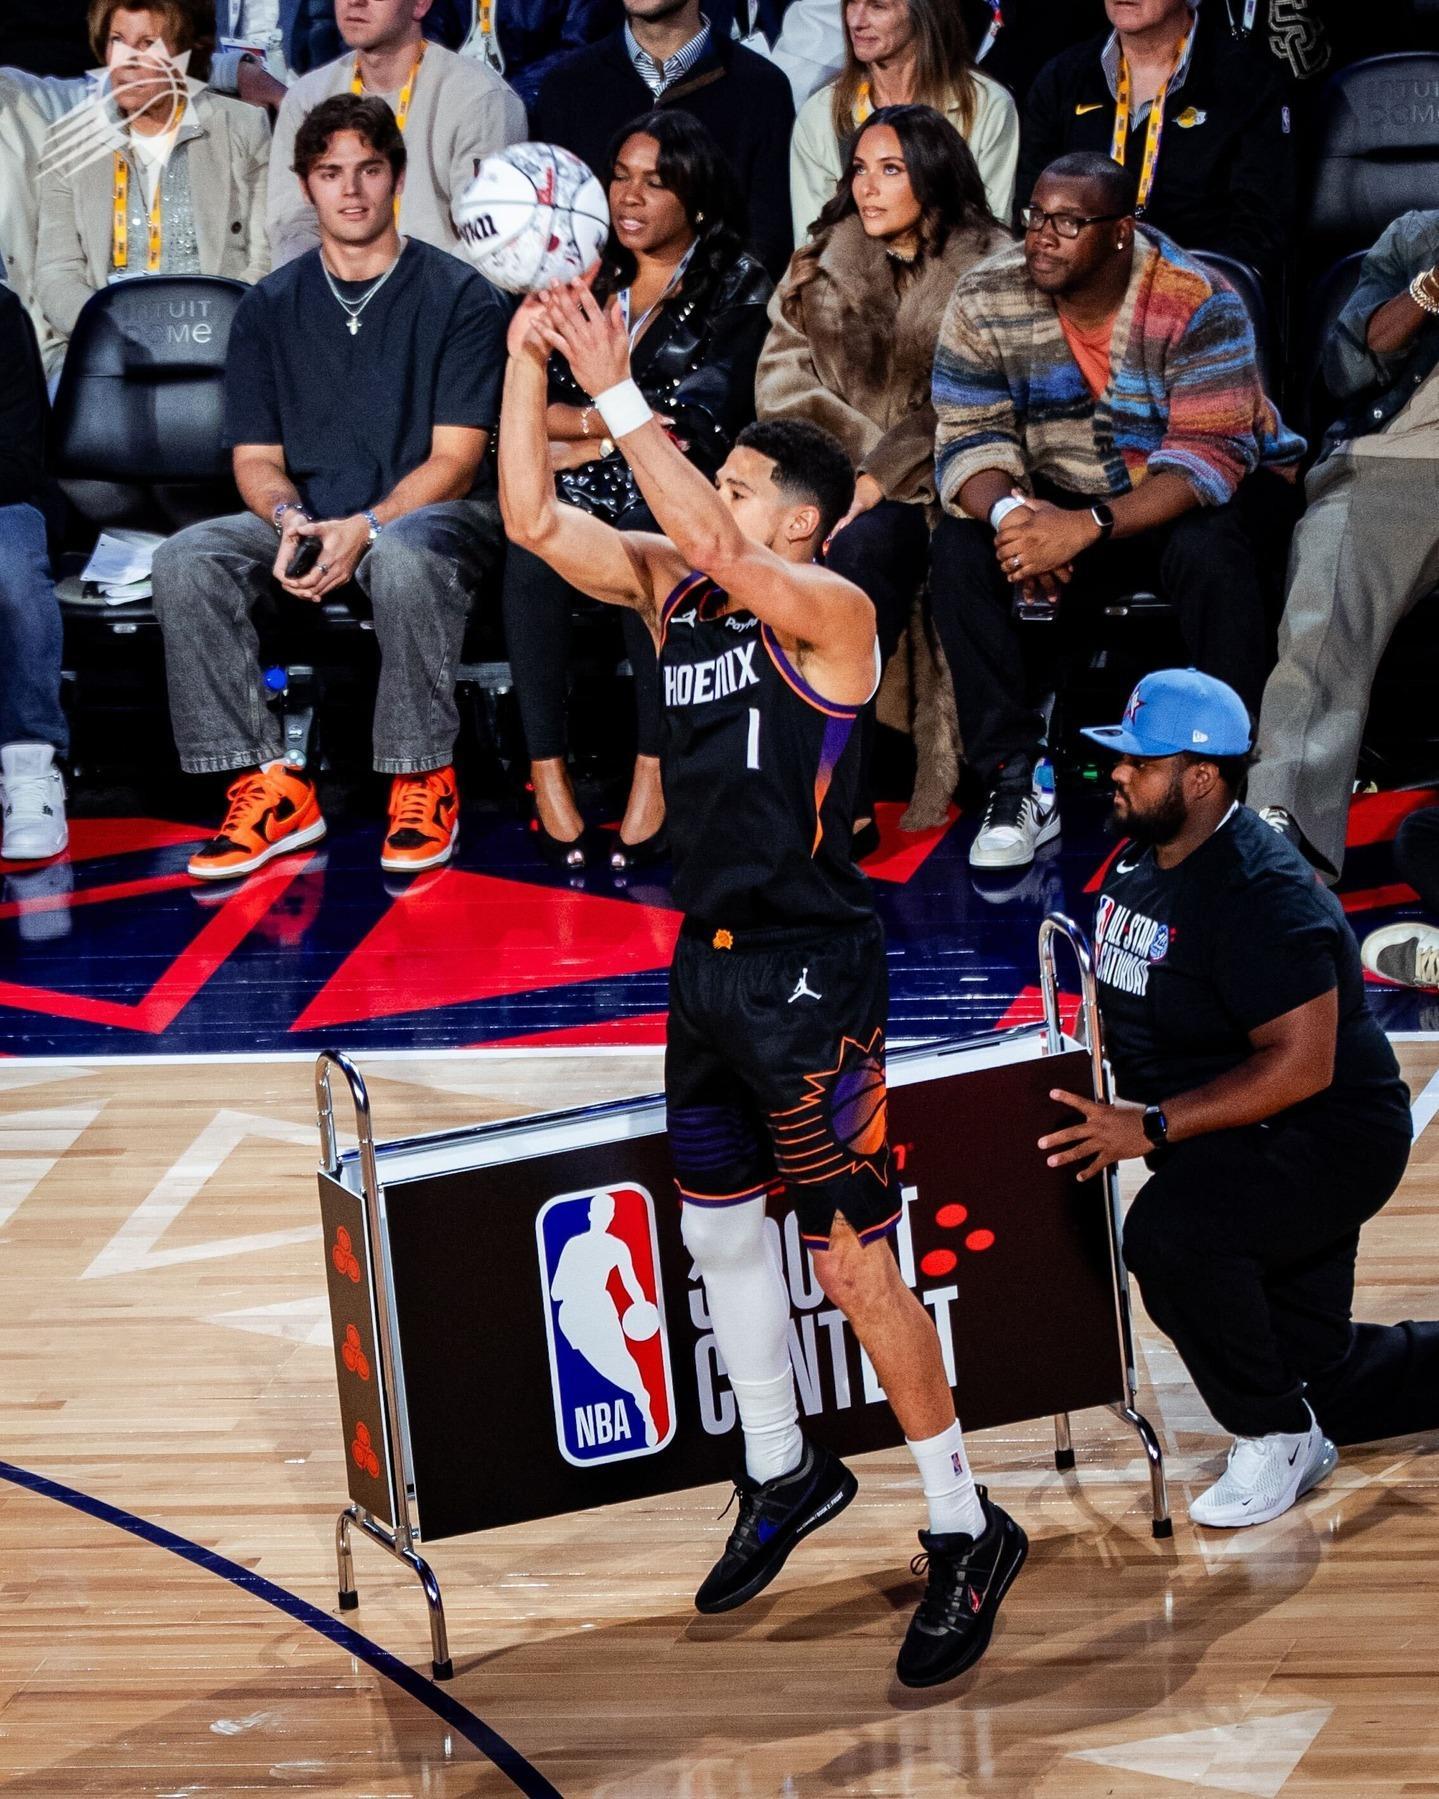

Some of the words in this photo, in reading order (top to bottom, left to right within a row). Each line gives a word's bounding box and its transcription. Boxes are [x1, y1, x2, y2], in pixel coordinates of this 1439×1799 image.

[123, 300, 212, 319] TUIT
[746, 707, 761, 771] 1
[694, 1285, 959, 1435] CNTT
[574, 1398, 632, 1449] NBA
